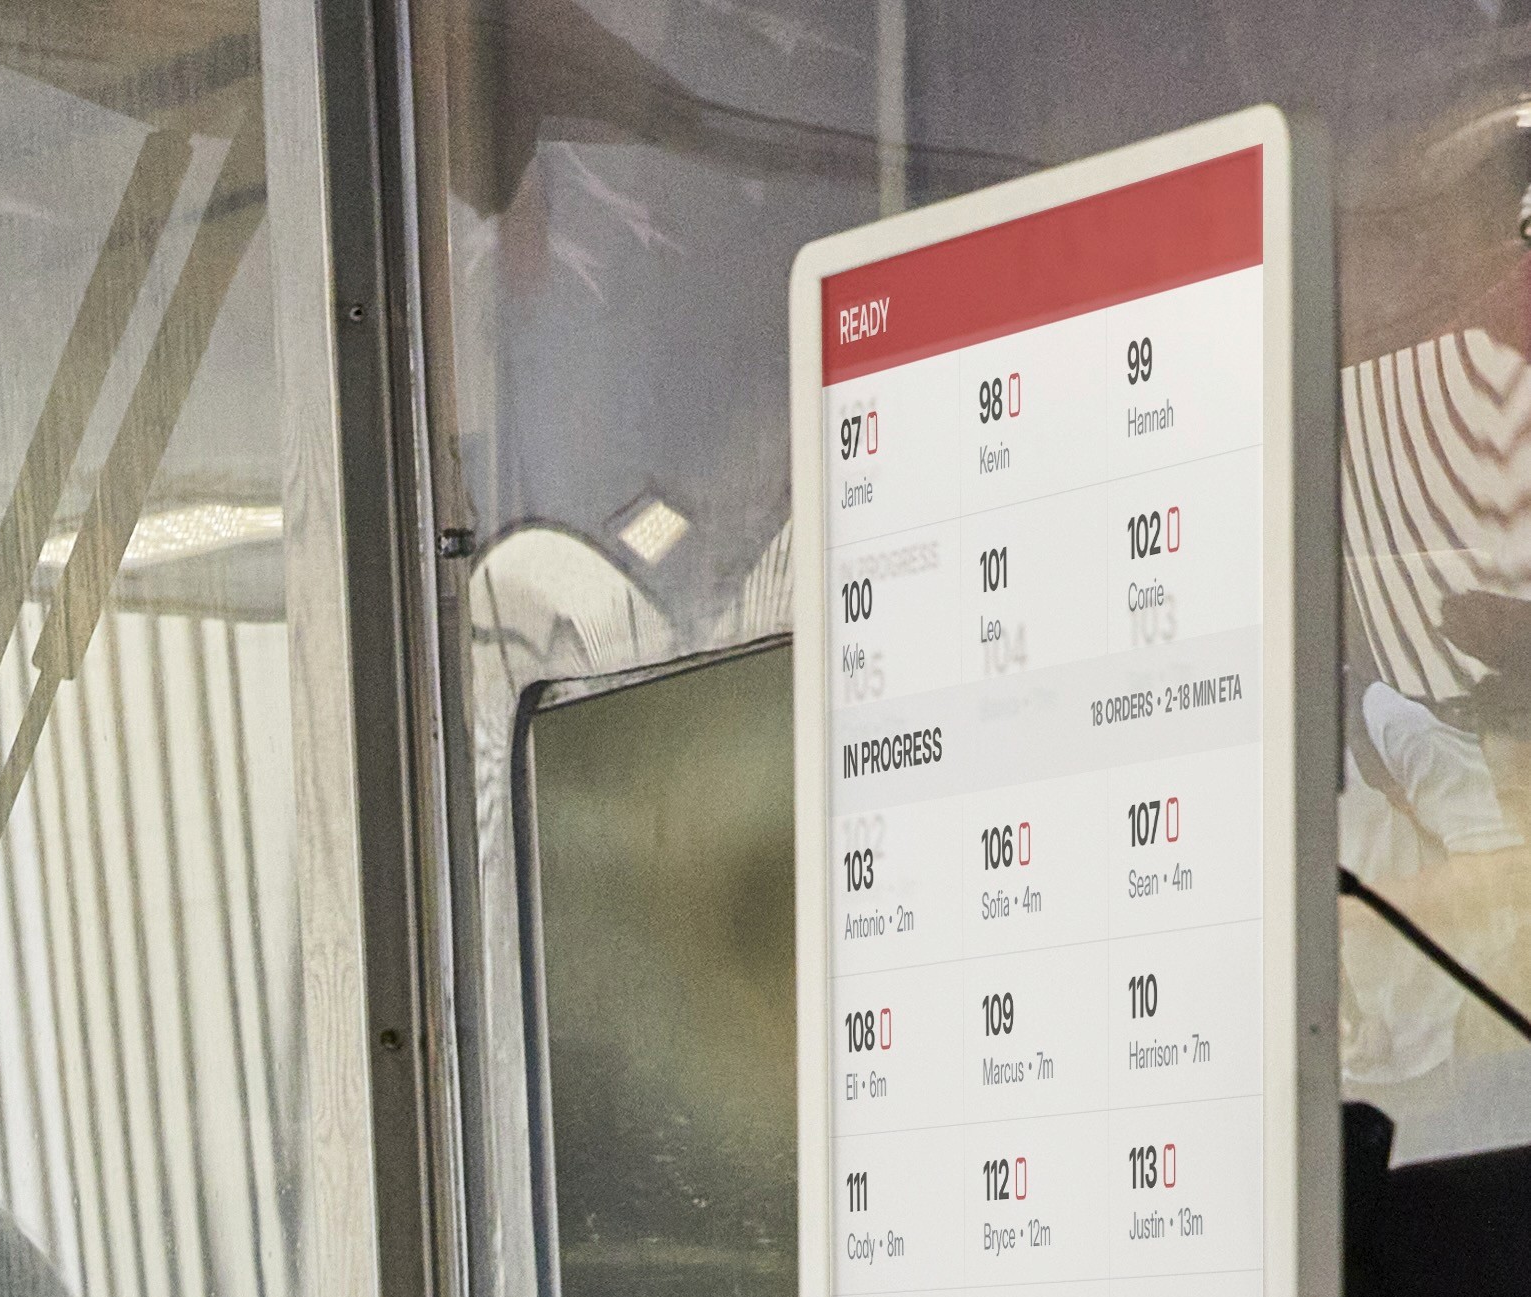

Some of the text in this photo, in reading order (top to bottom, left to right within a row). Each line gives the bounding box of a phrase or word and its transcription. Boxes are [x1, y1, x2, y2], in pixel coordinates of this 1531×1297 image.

[840, 297, 890, 344] READY
[1128, 337, 1152, 385] 99
[979, 378, 1002, 424] 98
[1128, 399, 1173, 437] Hannah
[841, 416, 861, 460] 97
[980, 442, 1010, 474] Kevin
[841, 477, 873, 509] Jamie
[1128, 511, 1161, 559] 102
[980, 547, 1007, 592] 101
[842, 578, 872, 623] 100
[1128, 582, 1164, 613] Corrie
[981, 616, 1002, 643] Leo
[843, 644, 865, 678] Kyle
[1091, 700, 1103, 726] 18
[1106, 691, 1153, 724] ORDERS
[1165, 684, 1190, 713] 2-18
[1193, 679, 1216, 707] MIN
[1219, 674, 1242, 703] ETA
[844, 727, 942, 778] IN PROGRESS
[1128, 800, 1160, 847] 107
[982, 825, 1013, 870] 106
[844, 848, 873, 892] 103
[1129, 863, 1192, 898] Sean 4m
[845, 905, 914, 940] Antonio 2m
[982, 886, 1041, 920] Sofia 4m
[983, 992, 1014, 1036] 109
[1129, 974, 1157, 1019] 110
[845, 1010, 875, 1052] 108
[1129, 1034, 1210, 1069] Harrison 7m
[846, 1071, 886, 1100] Eli 6m
[983, 1052, 1053, 1085] Marcus 7m
[983, 1159, 1009, 1201] 112
[1129, 1145, 1157, 1189] 113
[847, 1172, 867, 1212] 111
[984, 1219, 1050, 1256] Bryce 12m
[1129, 1207, 1203, 1240] Justin 13m
[847, 1230, 904, 1265] Cody 8m
